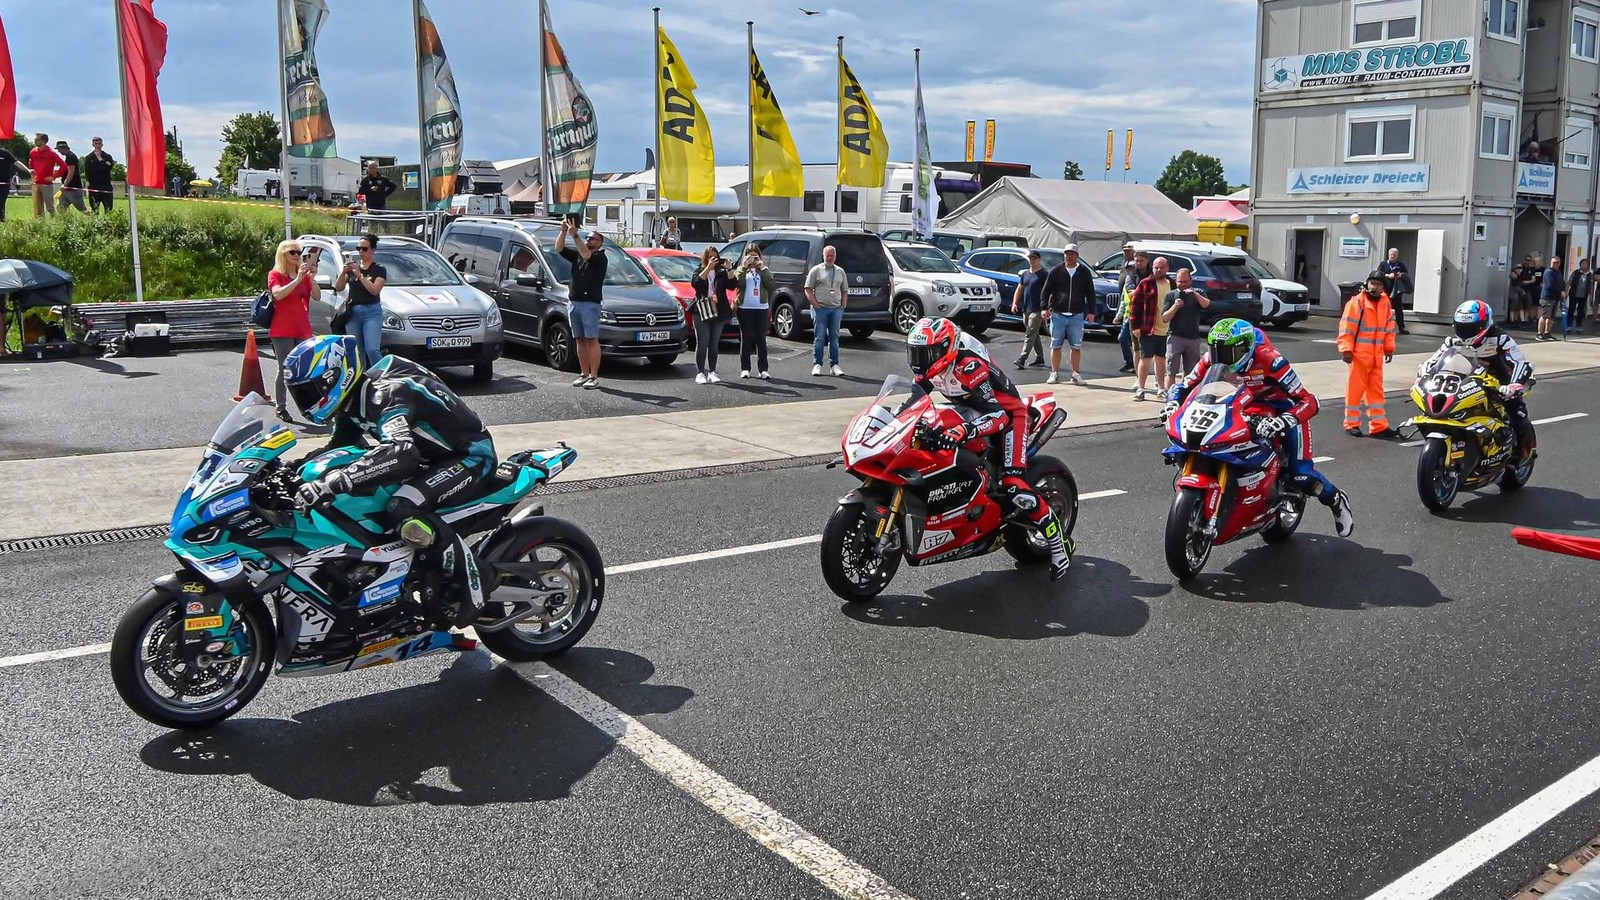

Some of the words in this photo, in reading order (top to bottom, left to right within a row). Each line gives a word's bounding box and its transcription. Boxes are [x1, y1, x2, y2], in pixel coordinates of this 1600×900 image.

[1302, 50, 1360, 77] MMS
[1364, 40, 1471, 71] STROBL
[1302, 75, 1359, 87] www.MOBILE
[1309, 173, 1369, 186] Schleizer
[1372, 171, 1425, 184] Dreieck
